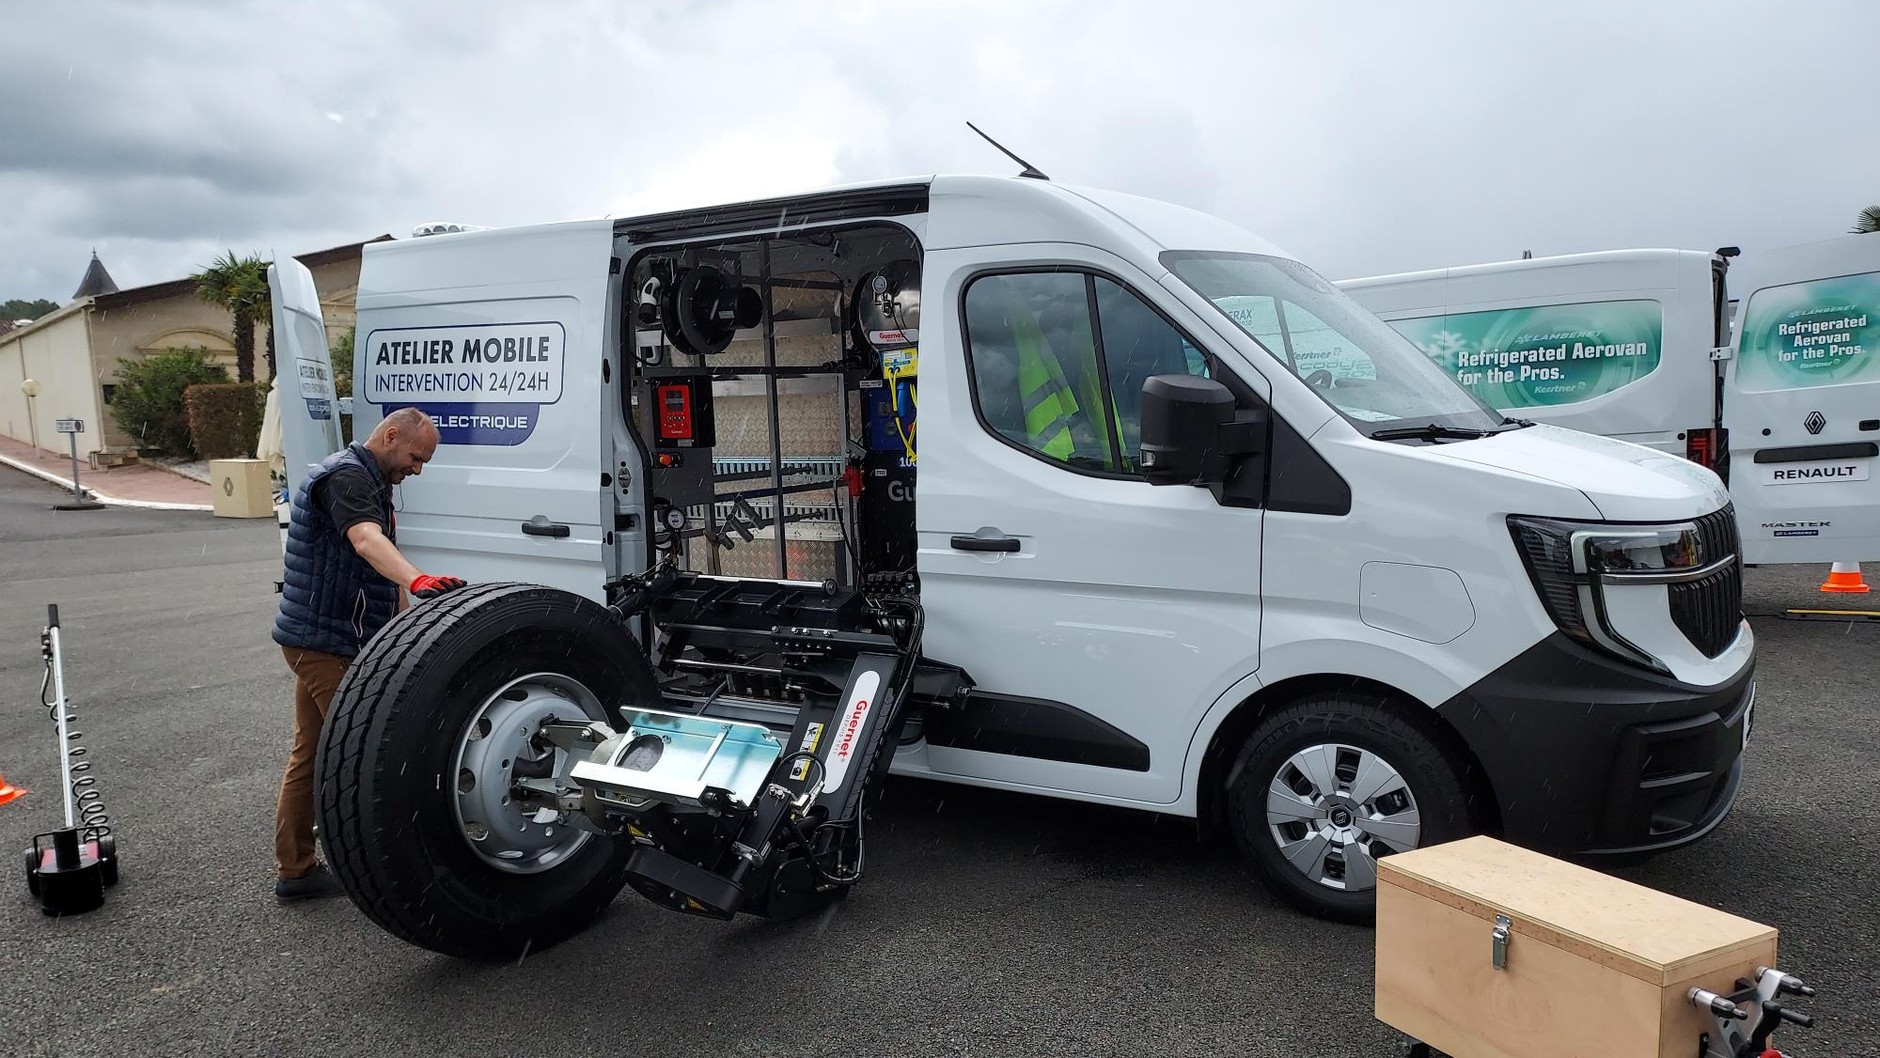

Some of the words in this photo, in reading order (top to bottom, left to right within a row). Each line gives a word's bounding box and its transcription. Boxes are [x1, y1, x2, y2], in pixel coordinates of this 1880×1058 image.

[1778, 314, 1867, 336] Refrigerated
[1532, 331, 1601, 341] LAMBERET
[1793, 333, 1851, 347] Aerovan
[376, 339, 454, 366] ATELIER
[461, 336, 550, 364] MOBILE
[1458, 344, 1566, 368] Refrigerated
[1571, 342, 1647, 360] Aerovan
[1778, 350, 1798, 362] for
[1802, 347, 1825, 360] the
[1829, 344, 1866, 357] Pros.
[375, 372, 483, 392] INTERVENTION
[488, 370, 549, 396] 24/24H
[1456, 369, 1482, 386] for
[1487, 368, 1514, 384] the
[1520, 365, 1565, 382] Pros.
[1773, 466, 1857, 480] RENAULT
[838, 700, 868, 758] Guernet
